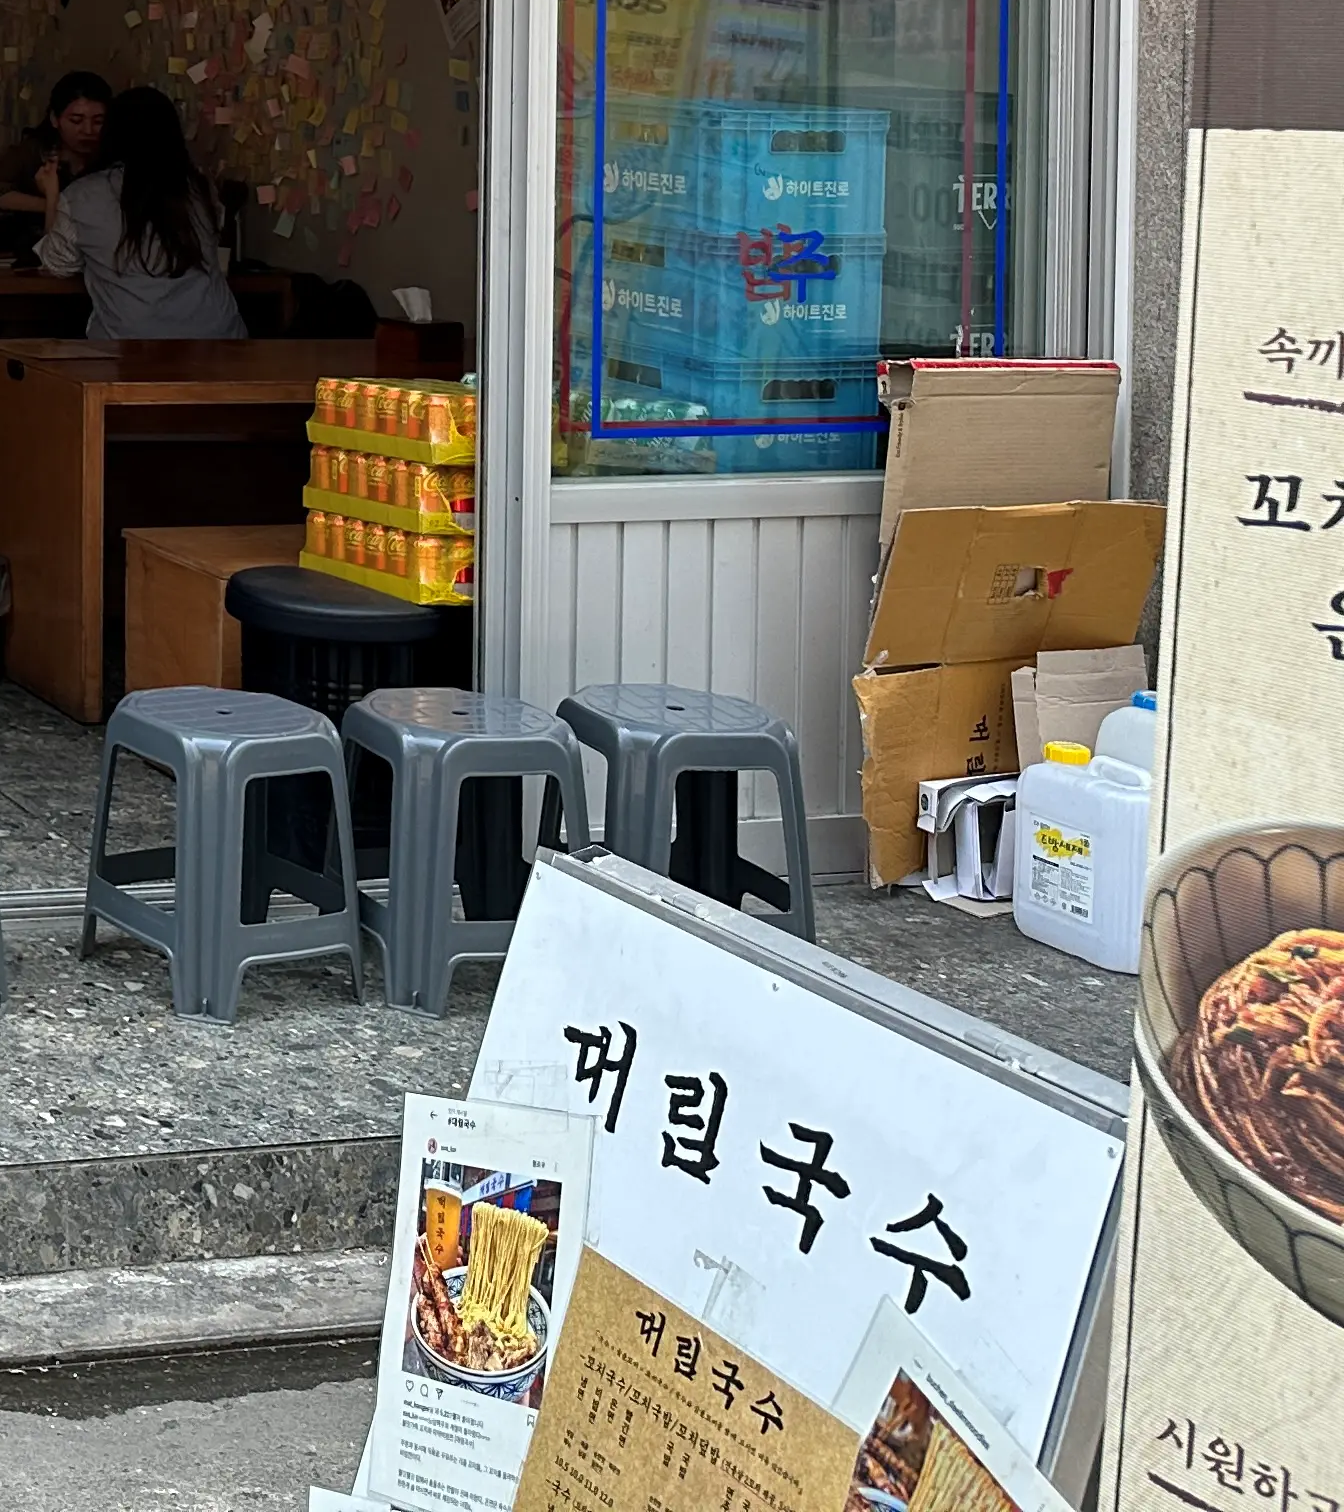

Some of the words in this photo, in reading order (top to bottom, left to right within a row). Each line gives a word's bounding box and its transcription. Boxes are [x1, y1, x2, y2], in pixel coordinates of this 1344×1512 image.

[622, 168, 687, 196] 하이트진로
[786, 179, 850, 199] 하이트진로
[618, 287, 683, 318] 하이트진로
[783, 304, 848, 321] 하이트진로
[563, 1020, 972, 1315] 대림국수
[635, 1311, 785, 1435] 대림국수
